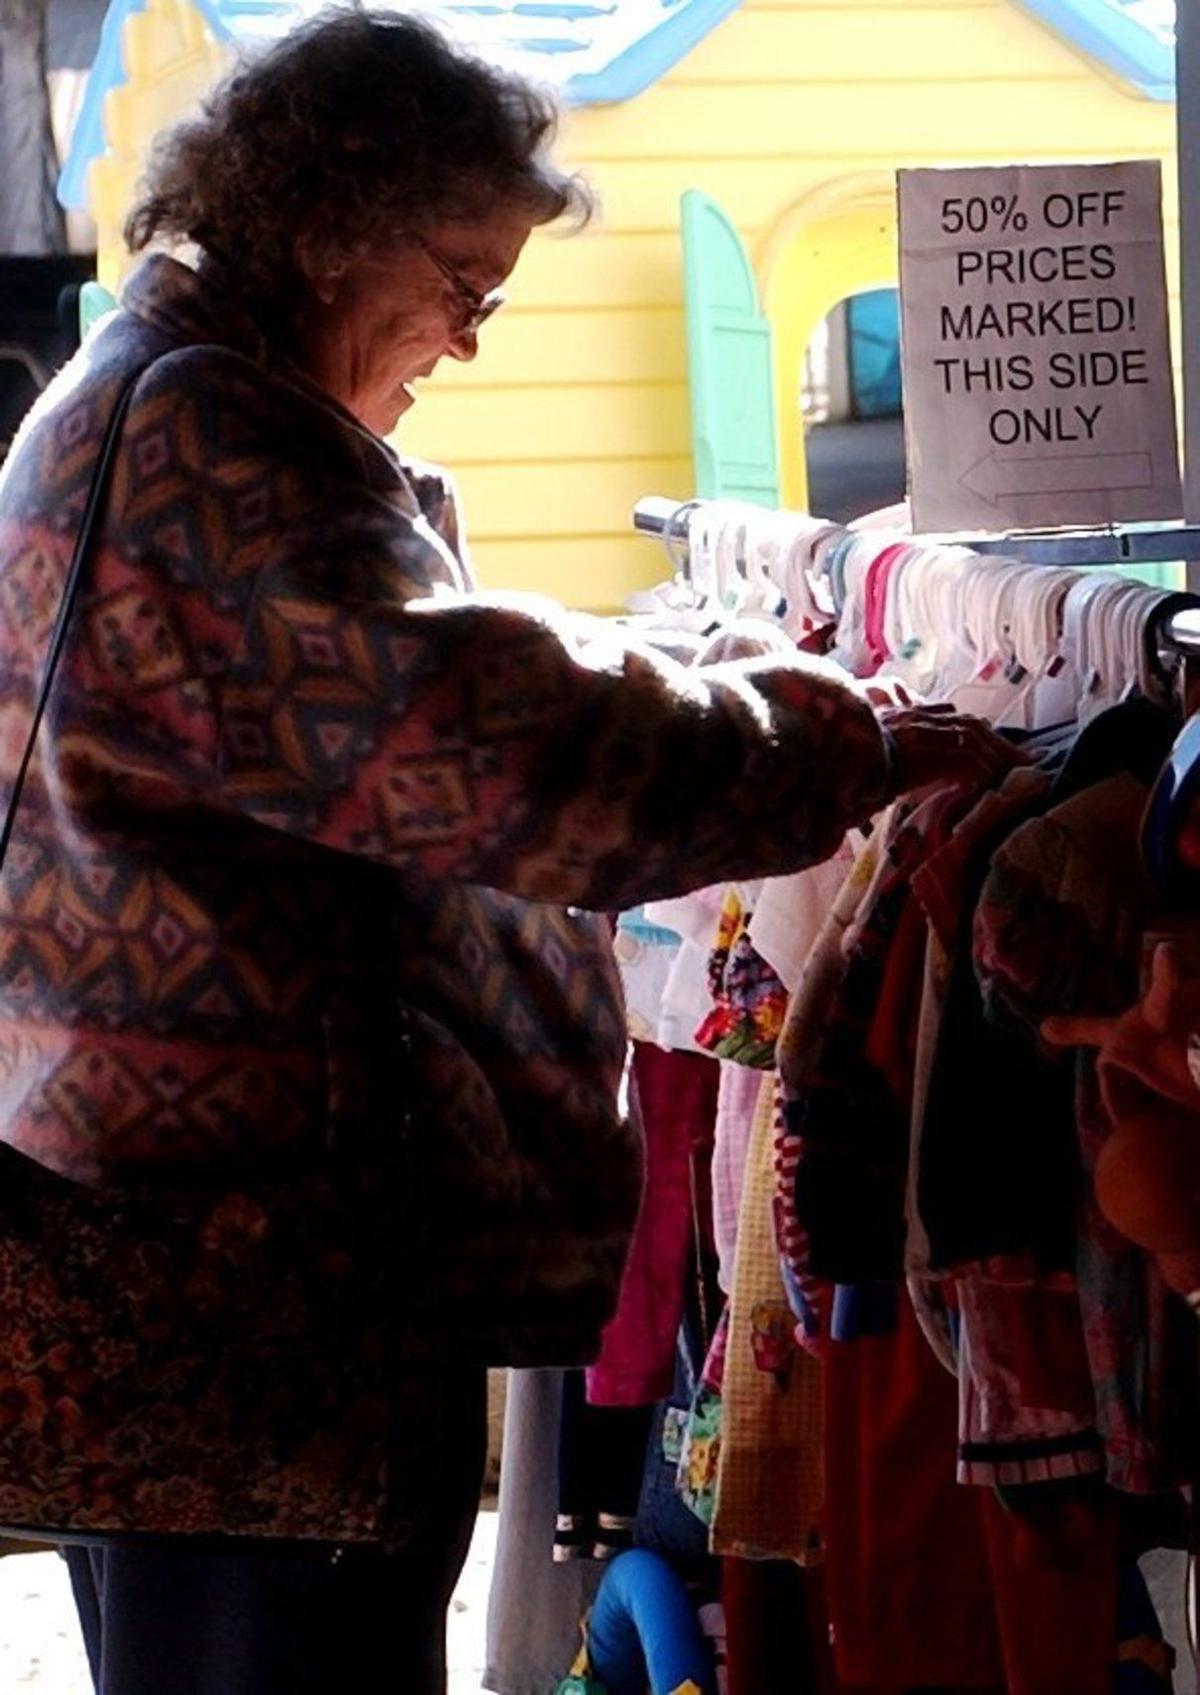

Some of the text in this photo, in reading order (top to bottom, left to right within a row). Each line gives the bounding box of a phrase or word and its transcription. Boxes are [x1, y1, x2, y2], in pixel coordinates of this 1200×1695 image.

[941, 190, 1125, 233] 50% OFF
[957, 244, 1116, 286] PRICES
[940, 296, 1137, 341] MARKED!
[934, 350, 1149, 393] THIS SIDE
[989, 405, 1103, 445] ONLY
